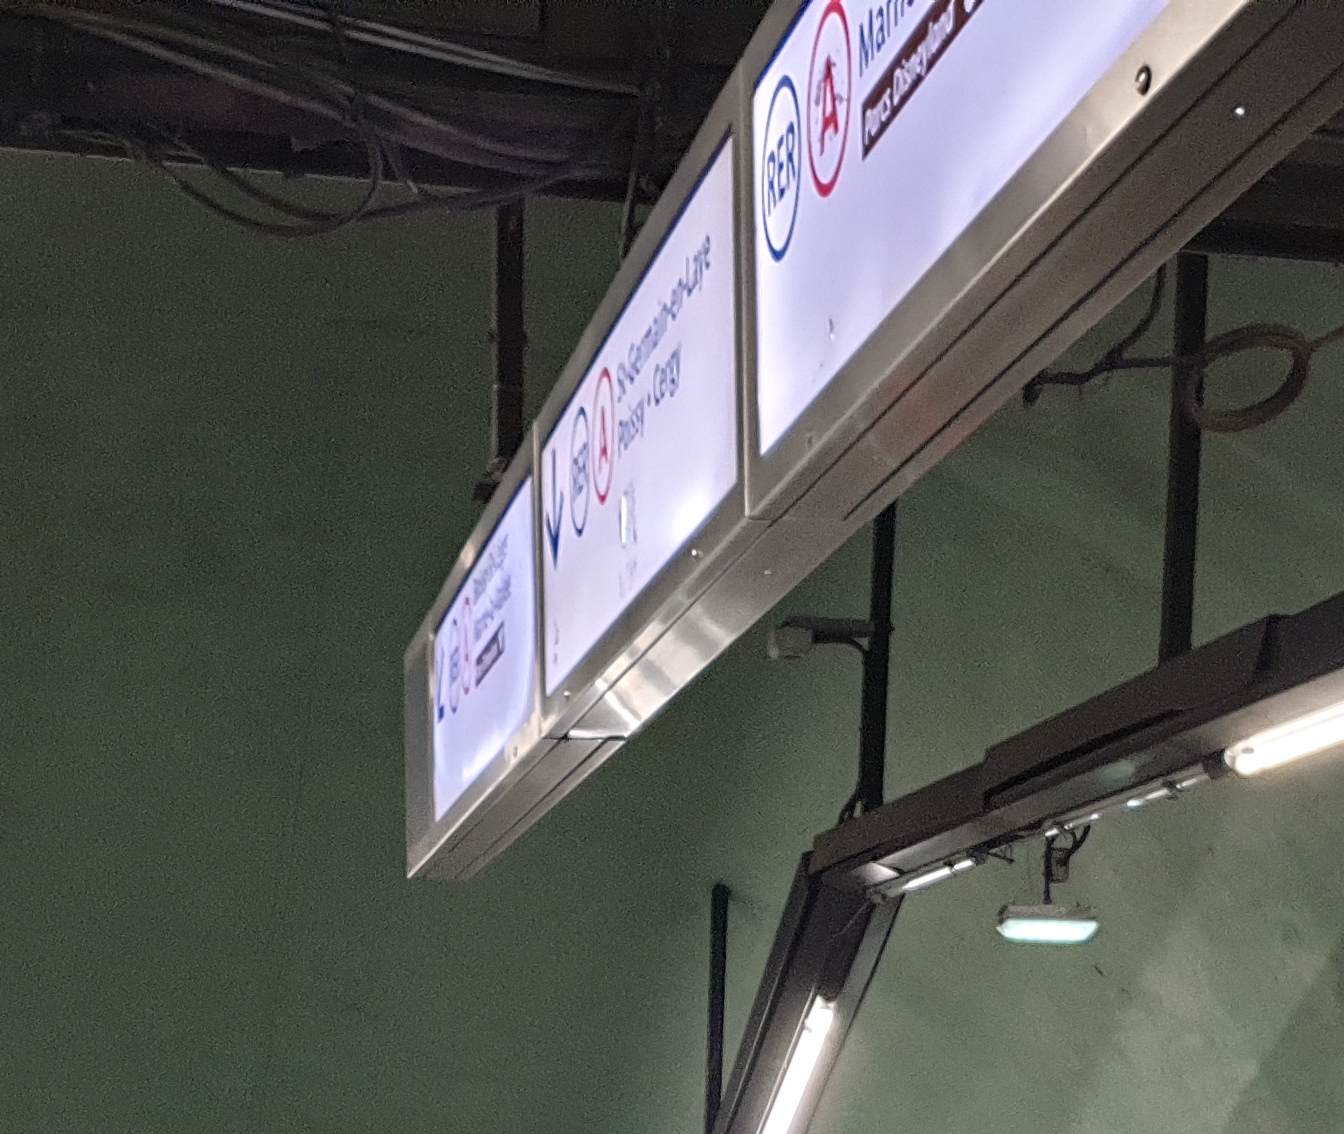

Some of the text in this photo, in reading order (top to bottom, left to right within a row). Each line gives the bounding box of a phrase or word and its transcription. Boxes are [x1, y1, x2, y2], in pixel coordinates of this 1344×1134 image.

[858, 0, 915, 79] Marn
[818, 55, 839, 157] A
[766, 120, 797, 217] RER
